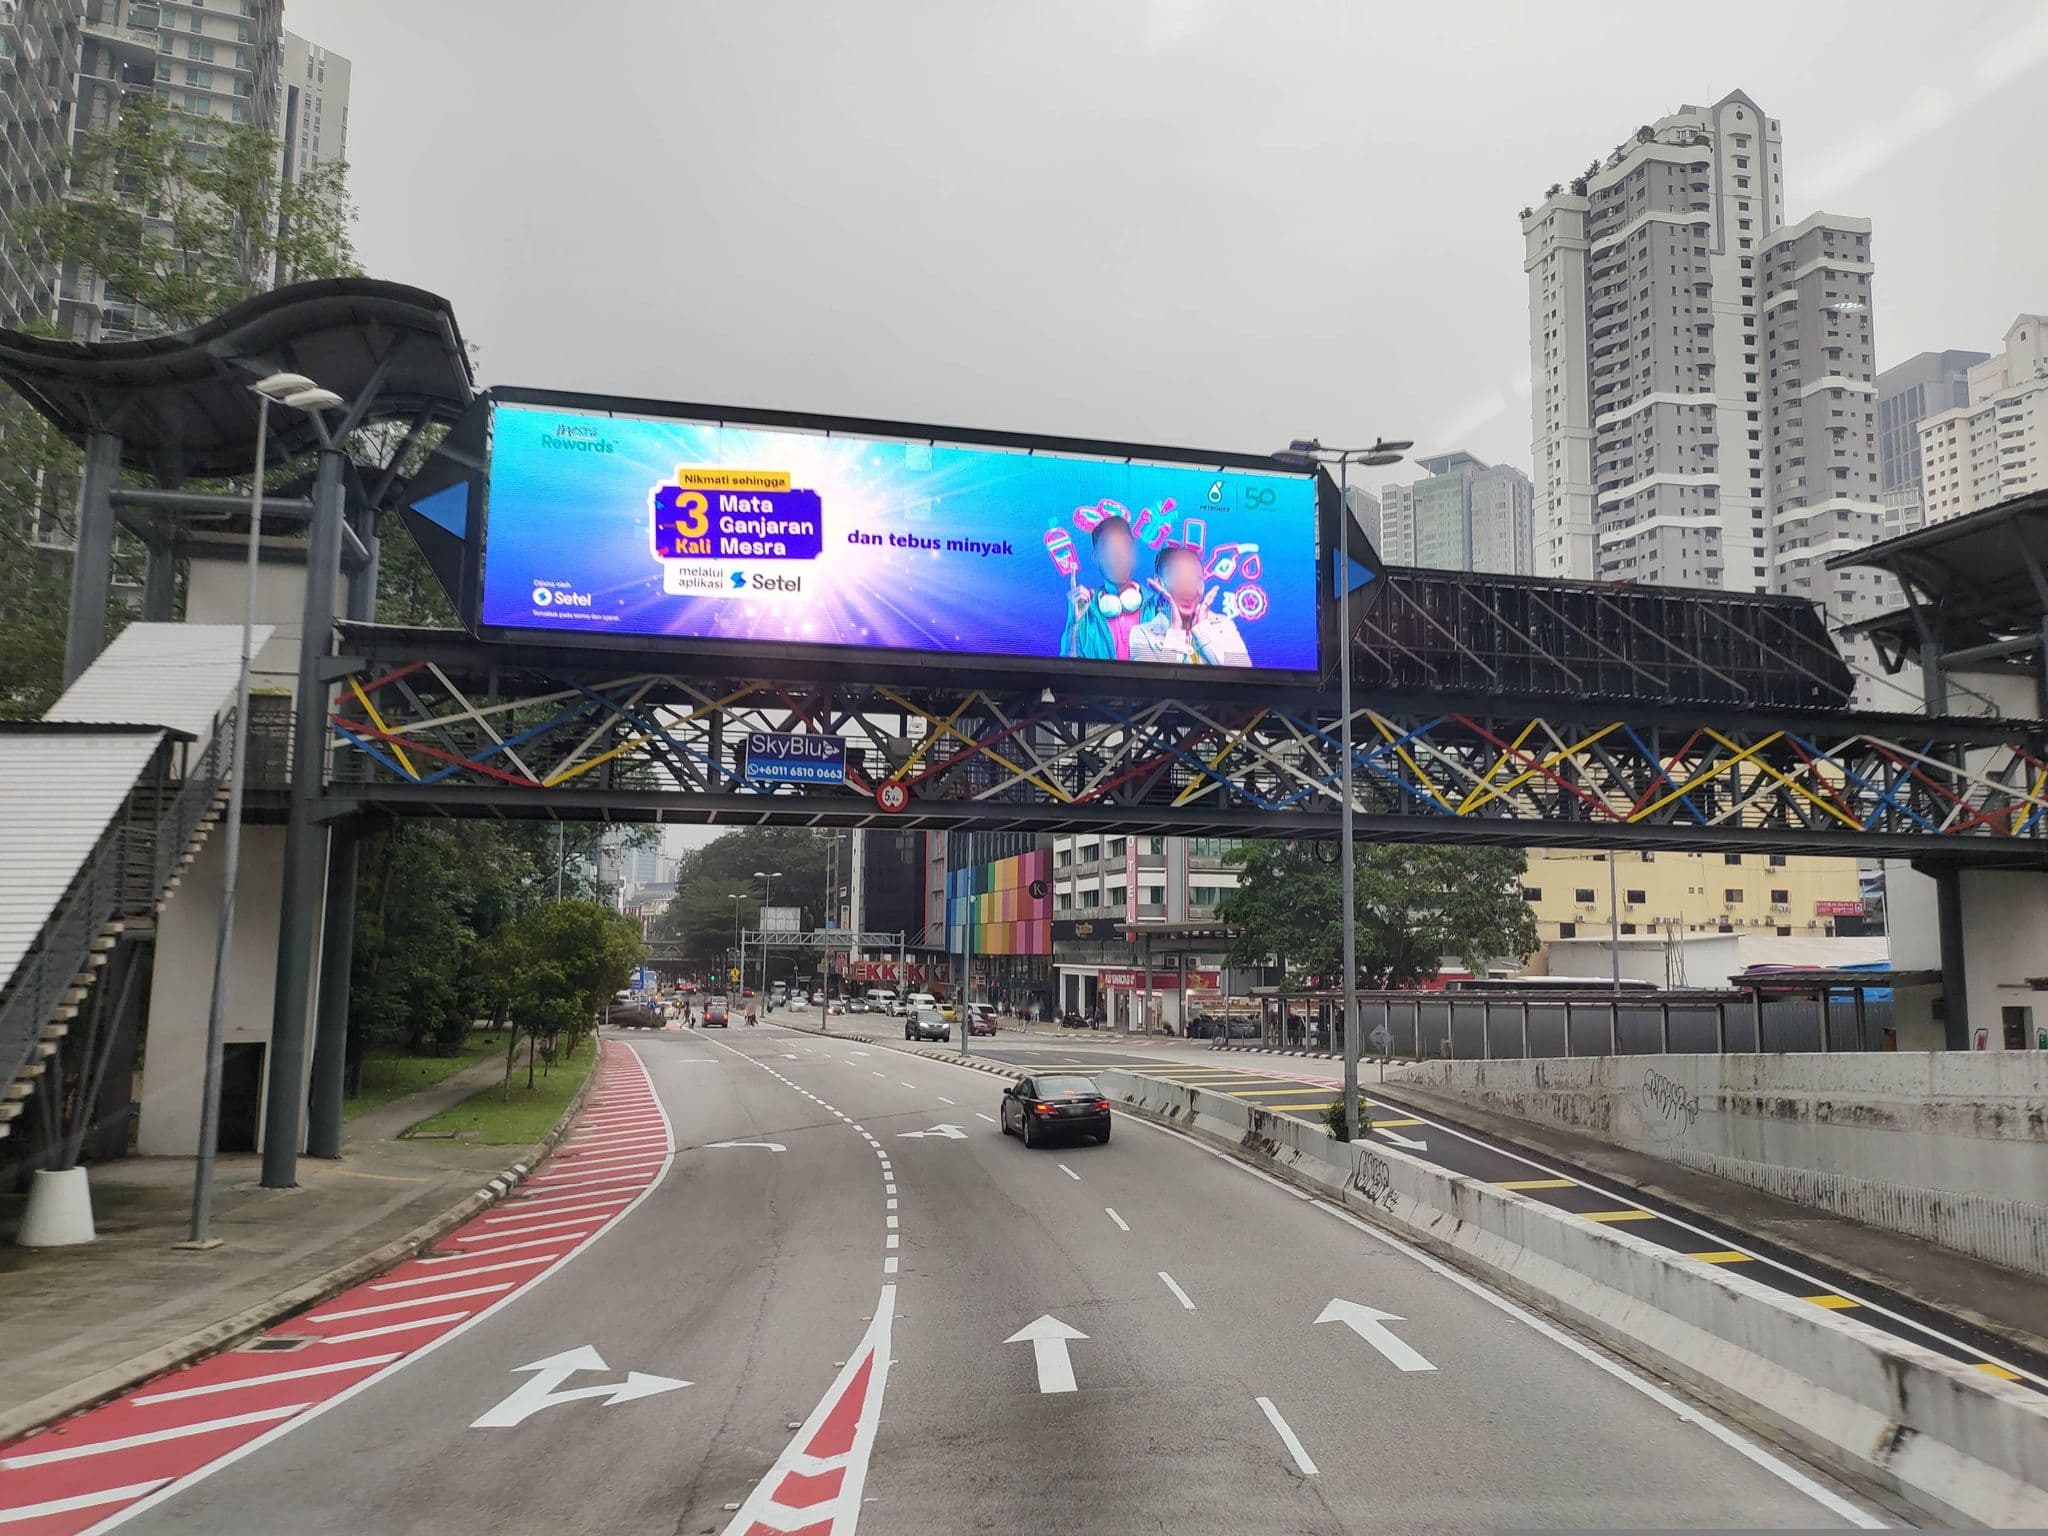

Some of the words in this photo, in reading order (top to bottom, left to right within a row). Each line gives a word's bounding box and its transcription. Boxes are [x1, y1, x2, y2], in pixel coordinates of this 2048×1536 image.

[542, 434, 614, 454] Rewards
[684, 474, 729, 485] Nikmati
[732, 475, 786, 488] sehingga
[719, 494, 774, 514] Mata
[675, 491, 709, 538] 3
[719, 516, 814, 538] Ganjaran
[675, 538, 711, 555] Kali
[719, 537, 786, 556] Mesra
[847, 529, 883, 545] dan
[889, 533, 941, 550] tebus
[946, 537, 1014, 558] minyak
[679, 567, 723, 578] melalui
[678, 578, 723, 589] aplikasi
[752, 573, 801, 592] Setel
[554, 591, 592, 607] Setel
[816, 767, 843, 779] 0663
